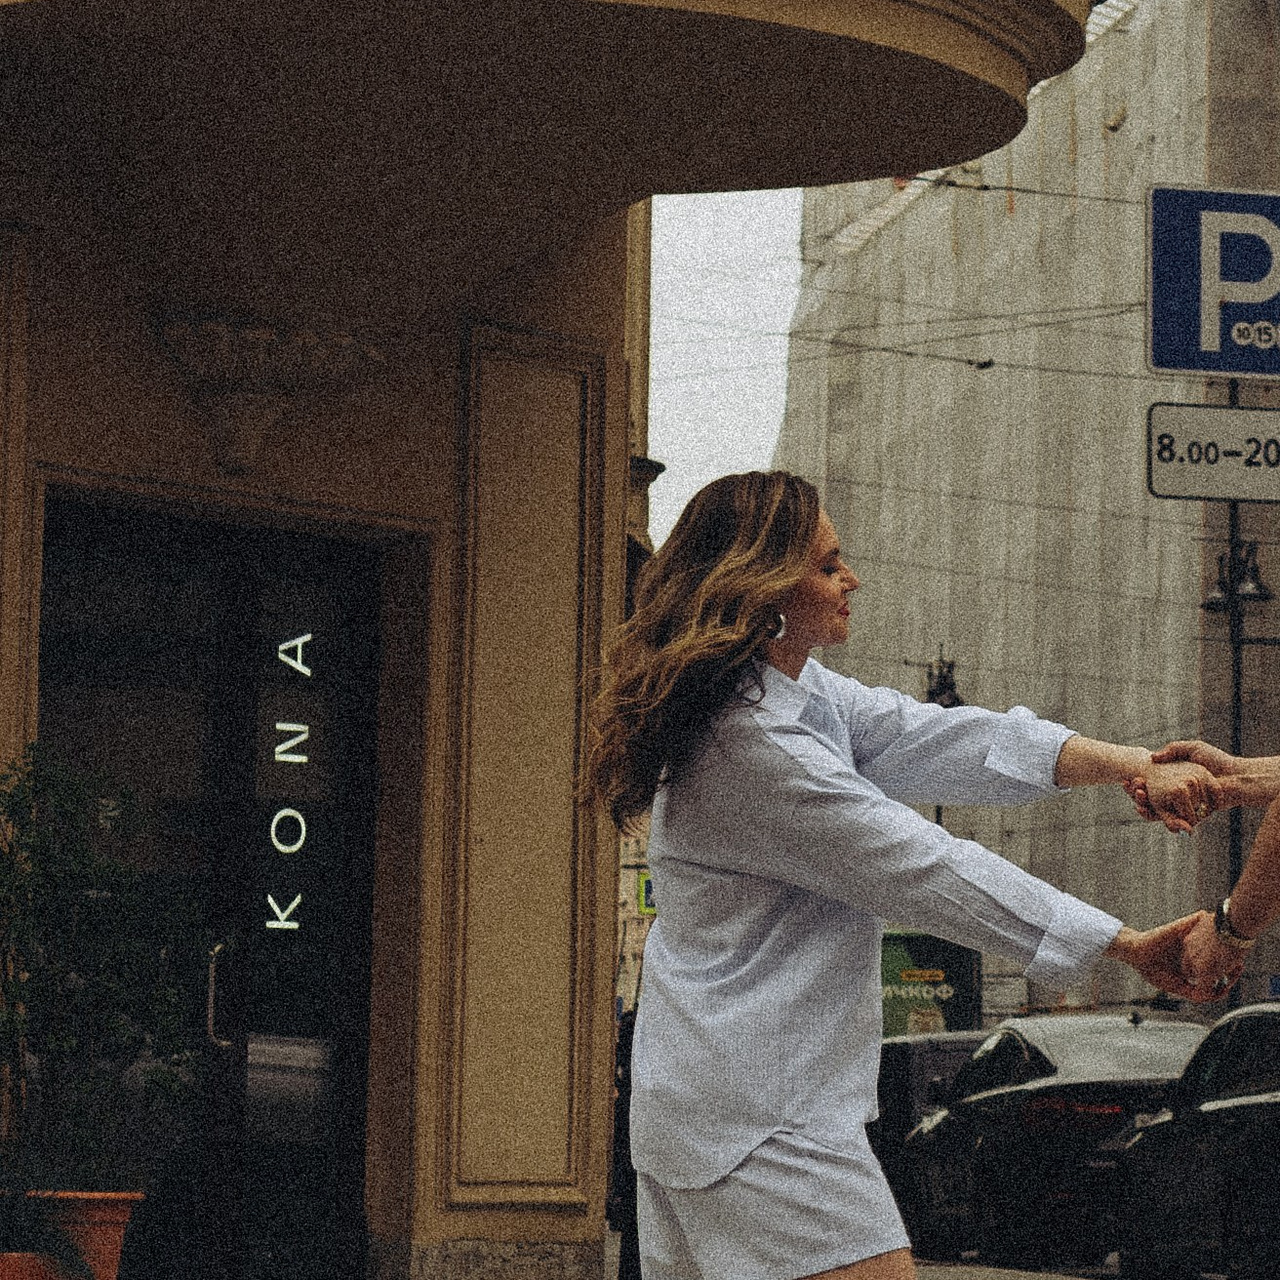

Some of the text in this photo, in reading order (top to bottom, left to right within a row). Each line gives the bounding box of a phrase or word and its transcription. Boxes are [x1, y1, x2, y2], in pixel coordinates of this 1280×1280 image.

[1236, 326, 1251, 339] 10
[1255, 326, 1273, 343] 15
[265, 632, 312, 931] KONA
